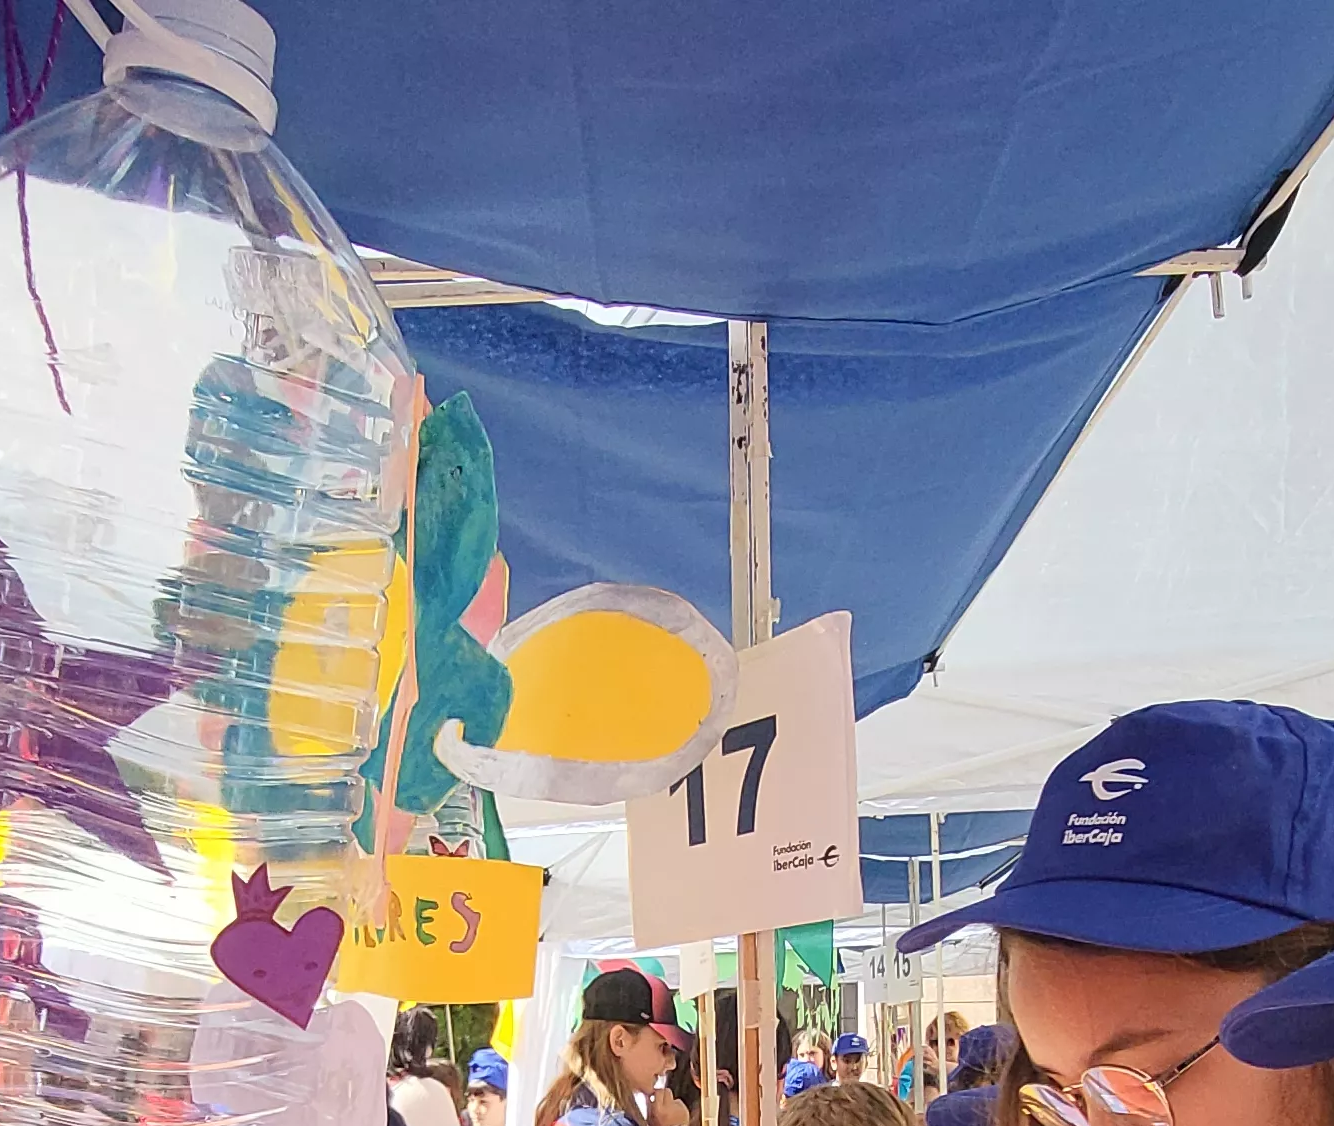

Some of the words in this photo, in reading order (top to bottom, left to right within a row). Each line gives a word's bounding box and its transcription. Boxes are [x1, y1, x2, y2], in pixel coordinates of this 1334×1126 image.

[670, 714, 777, 846] 17
[1067, 812, 1127, 827] Fundación
[772, 840, 812, 856] Fundación
[869, 954, 886, 979] 14
[893, 950, 911, 979] 15
